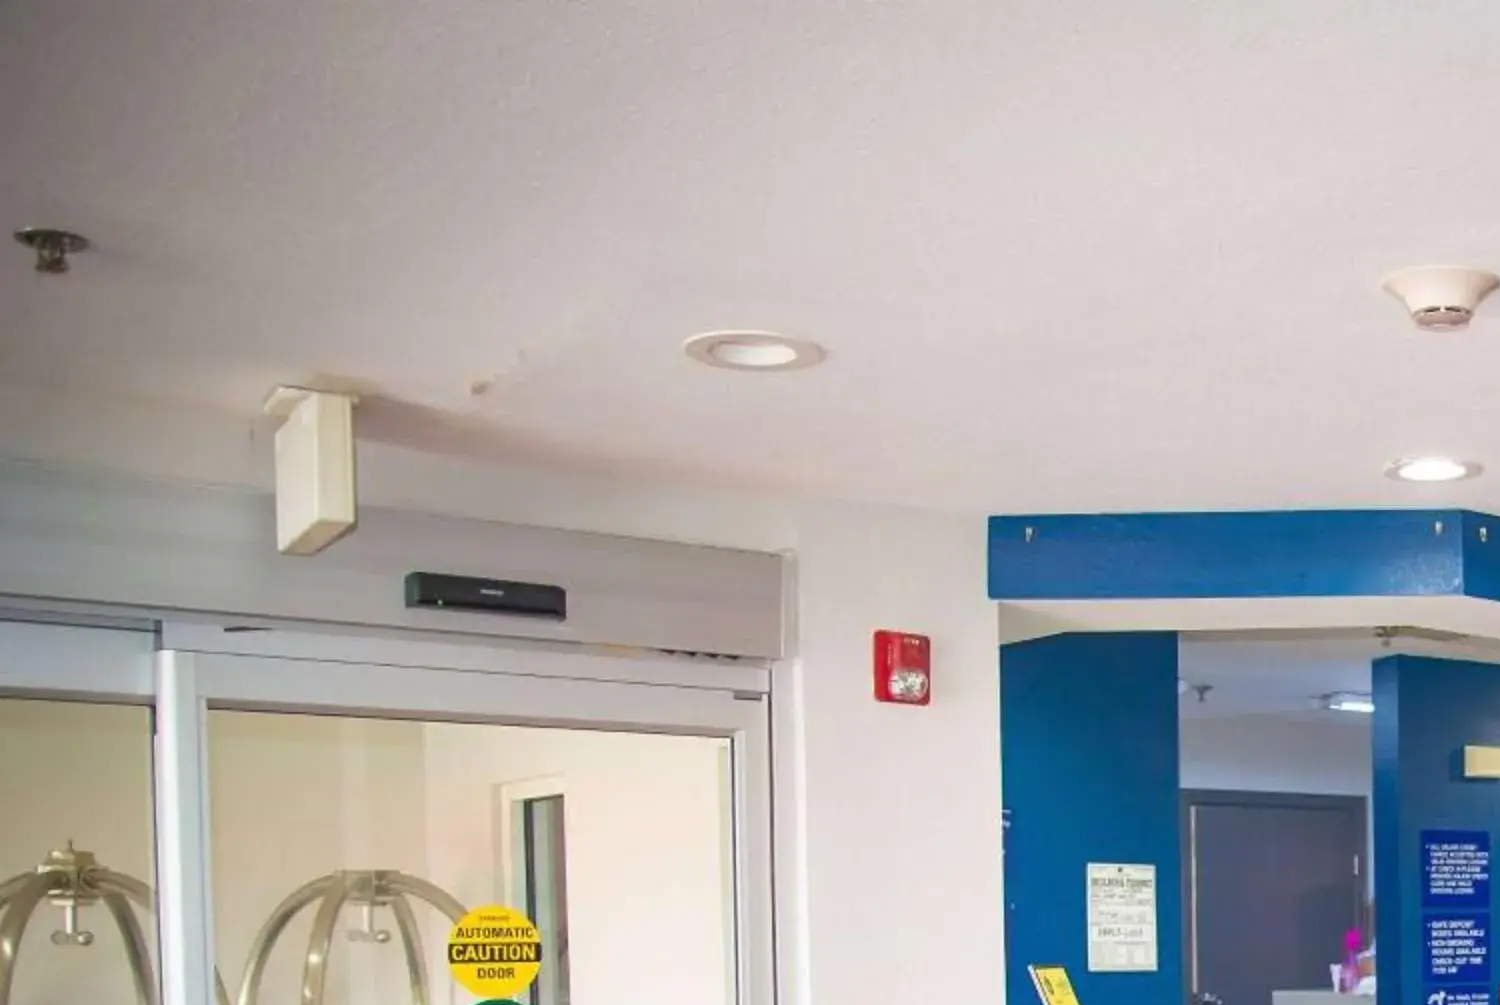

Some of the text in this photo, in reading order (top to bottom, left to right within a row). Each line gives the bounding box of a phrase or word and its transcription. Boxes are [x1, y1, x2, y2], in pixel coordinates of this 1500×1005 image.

[456, 927, 533, 939] AUTOMATIC
[451, 944, 536, 961] CAUTION
[476, 967, 516, 979] DOOR
